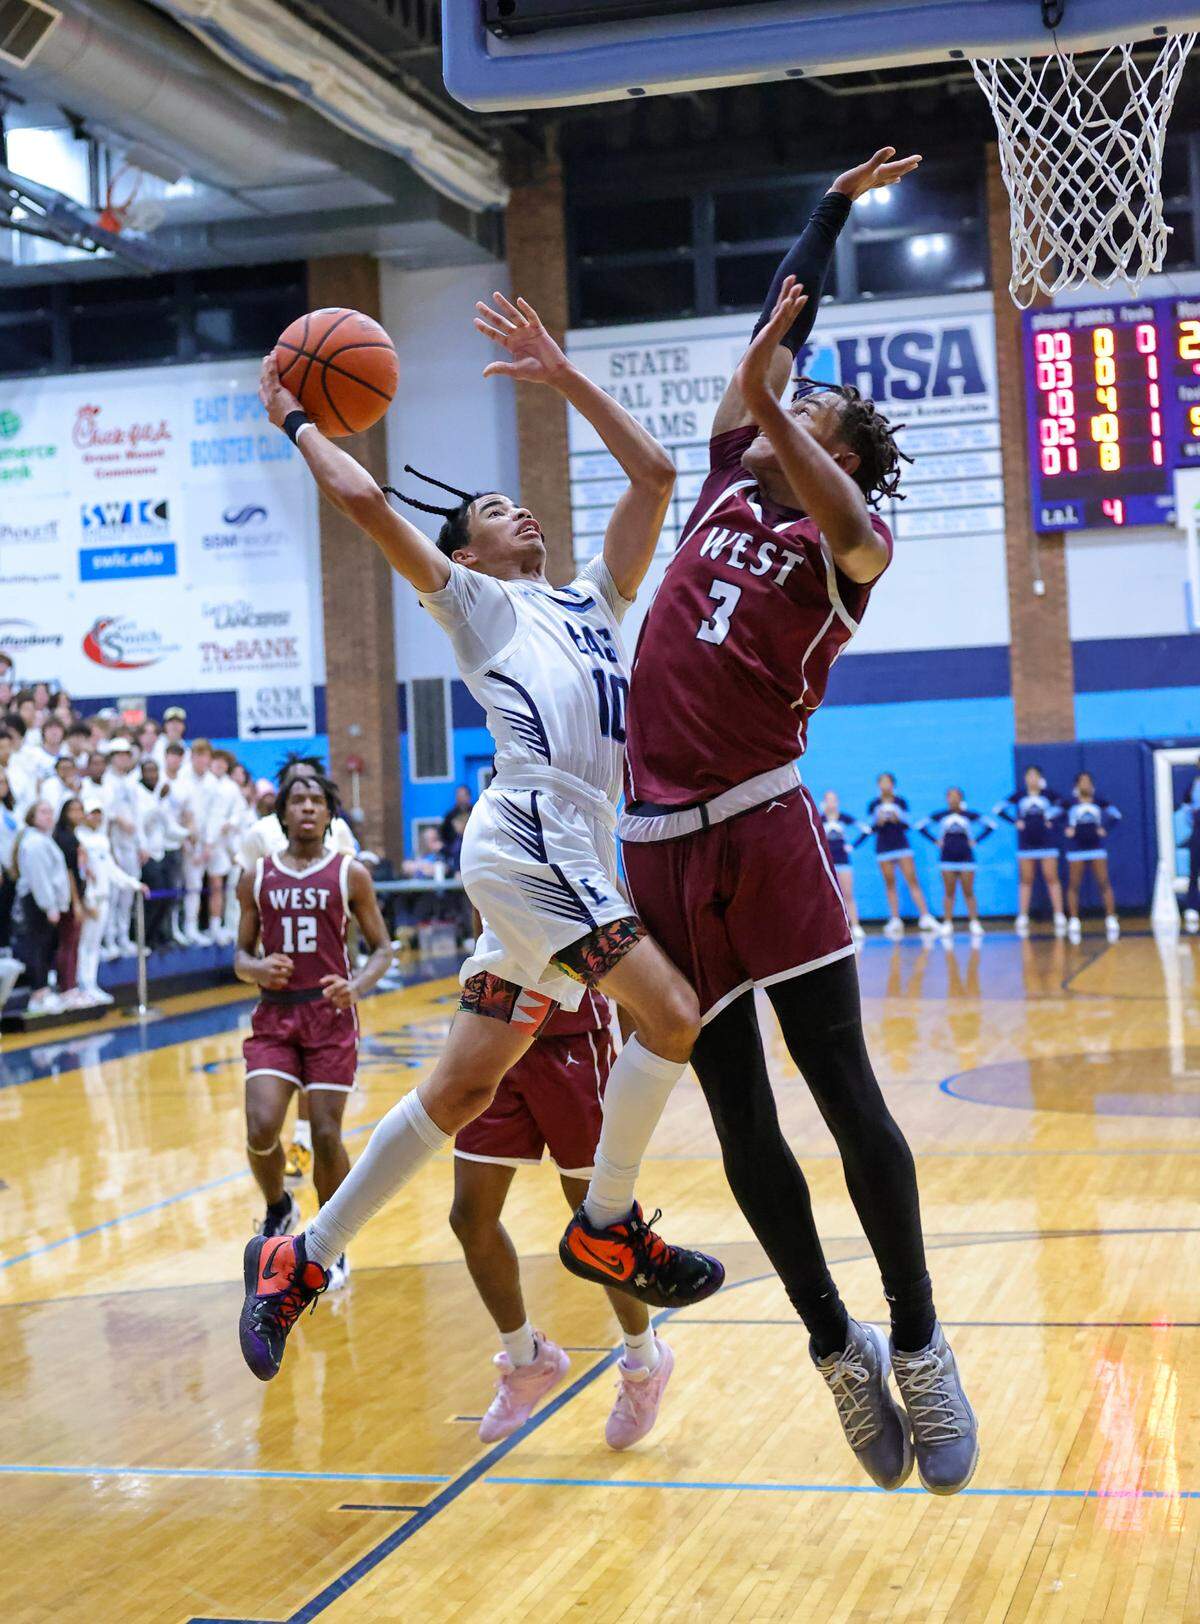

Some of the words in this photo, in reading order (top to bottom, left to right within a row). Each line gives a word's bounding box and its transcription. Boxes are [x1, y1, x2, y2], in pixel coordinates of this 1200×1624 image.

[1034, 331, 1072, 362] 00
[1093, 328, 1115, 358] 0
[1136, 324, 1156, 354] 0
[610, 347, 689, 378] STATE
[1037, 360, 1073, 391] 03
[1095, 356, 1116, 386] 0
[1148, 354, 1158, 380] 1
[1047, 388, 1074, 417] 10
[1096, 386, 1118, 412] 4
[1149, 382, 1160, 409] 1
[1039, 416, 1076, 447] 02
[1150, 411, 1161, 437] 1
[1041, 445, 1078, 476] 01
[1099, 441, 1121, 472] 8
[1152, 439, 1163, 466] 1
[1102, 498, 1124, 525] 4
[698, 525, 806, 588] WEST
[696, 578, 742, 646] 3
[247, 704, 309, 721] ANNEX
[256, 687, 302, 704] GYM
[591, 668, 629, 744] 10
[268, 887, 331, 911] WEST
[281, 916, 318, 954] 12
